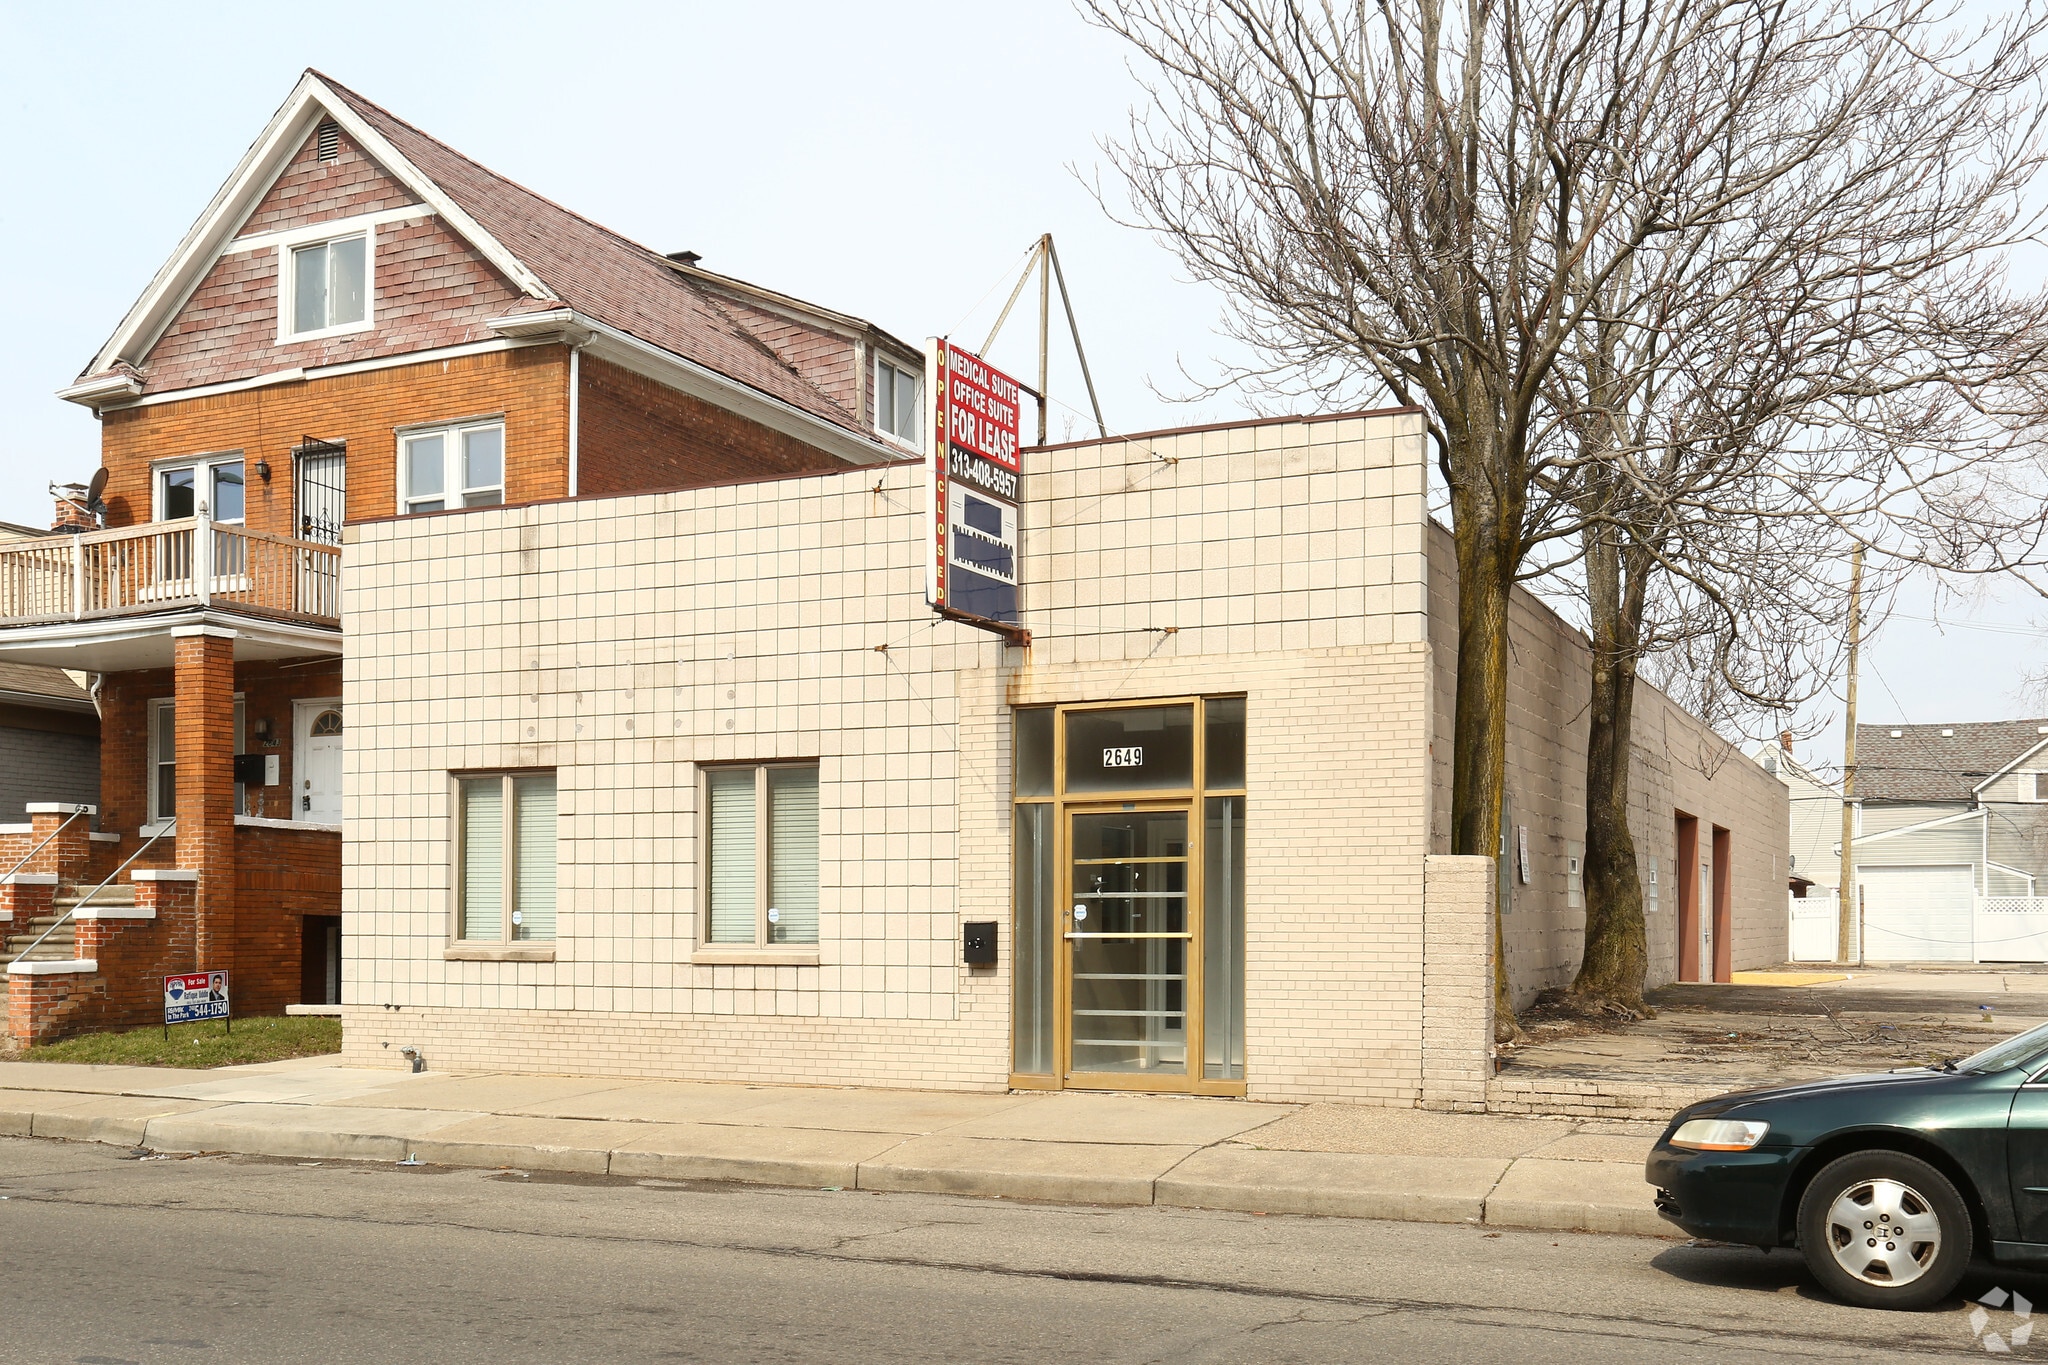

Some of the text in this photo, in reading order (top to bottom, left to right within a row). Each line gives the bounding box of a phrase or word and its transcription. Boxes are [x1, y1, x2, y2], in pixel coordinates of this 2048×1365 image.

[937, 349, 945, 459] OPEN
[950, 350, 1017, 405] MEDICAL SUITE
[953, 379, 1014, 428] OFFICE SUITE
[951, 404, 1016, 466] FOR LEASE
[951, 448, 1017, 499] 313-408-5957
[937, 480, 945, 600] CLOSED
[1105, 748, 1142, 766] 2649
[195, 1002, 227, 1017] 544-1750
